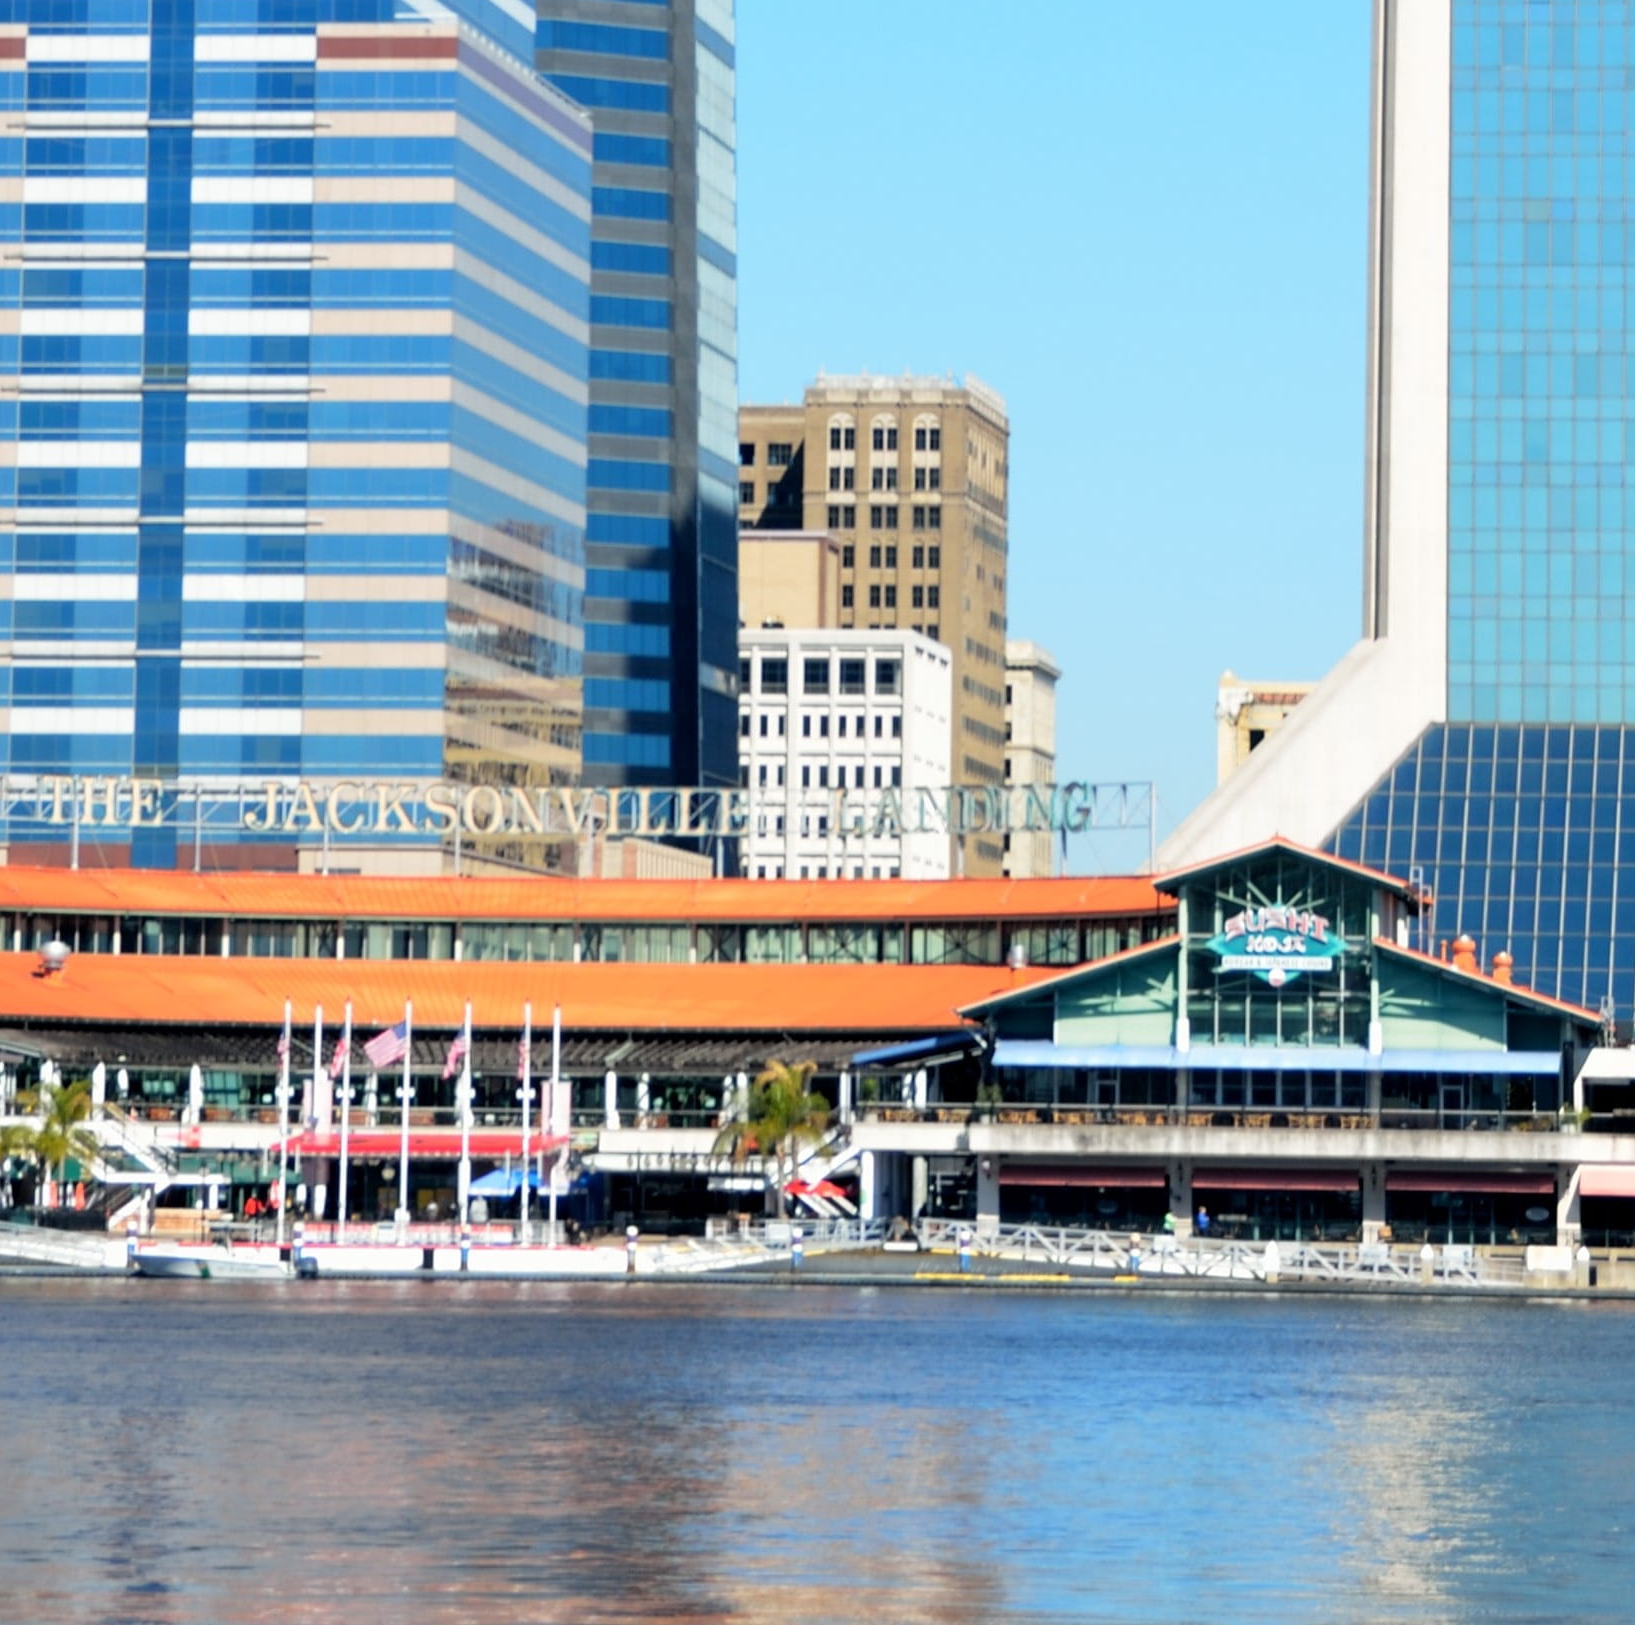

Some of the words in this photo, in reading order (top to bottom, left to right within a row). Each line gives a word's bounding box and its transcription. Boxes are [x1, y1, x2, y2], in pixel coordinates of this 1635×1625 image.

[39, 774, 164, 827] THE
[244, 780, 750, 837] JACKSONVILLE
[827, 780, 1092, 833] LANDING
[1224, 906, 1330, 943] SUSHI
